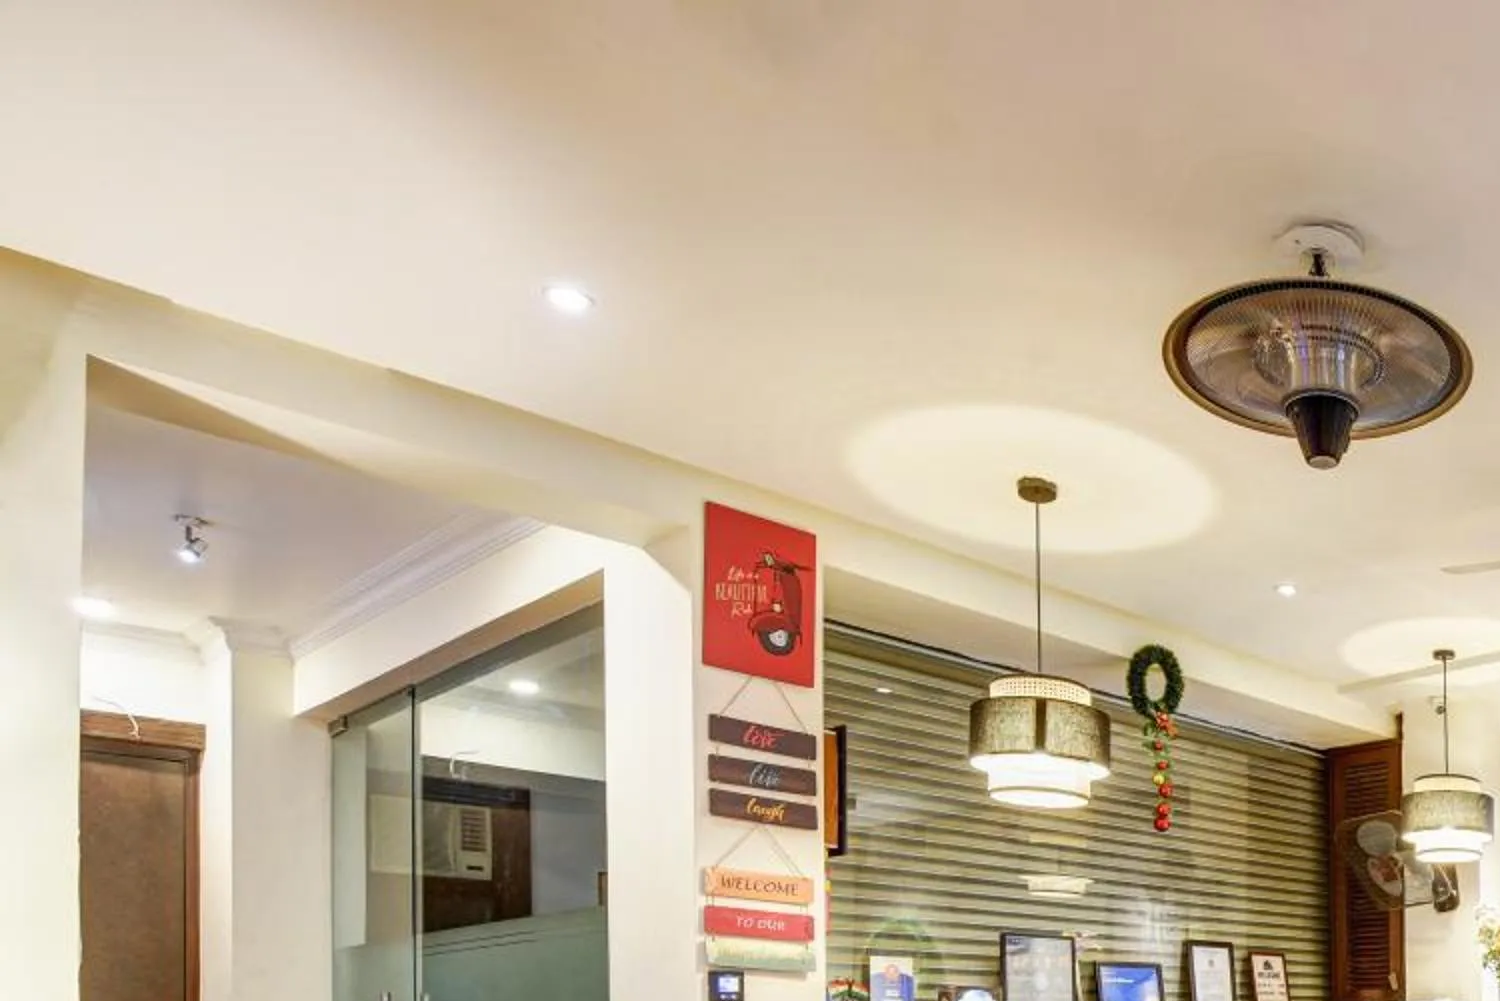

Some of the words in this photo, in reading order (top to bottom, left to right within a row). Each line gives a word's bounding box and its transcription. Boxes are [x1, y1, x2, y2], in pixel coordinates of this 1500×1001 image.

[721, 876, 799, 896] WELCOME
[736, 917, 752, 929] TO
[757, 919, 784, 931] OUR
